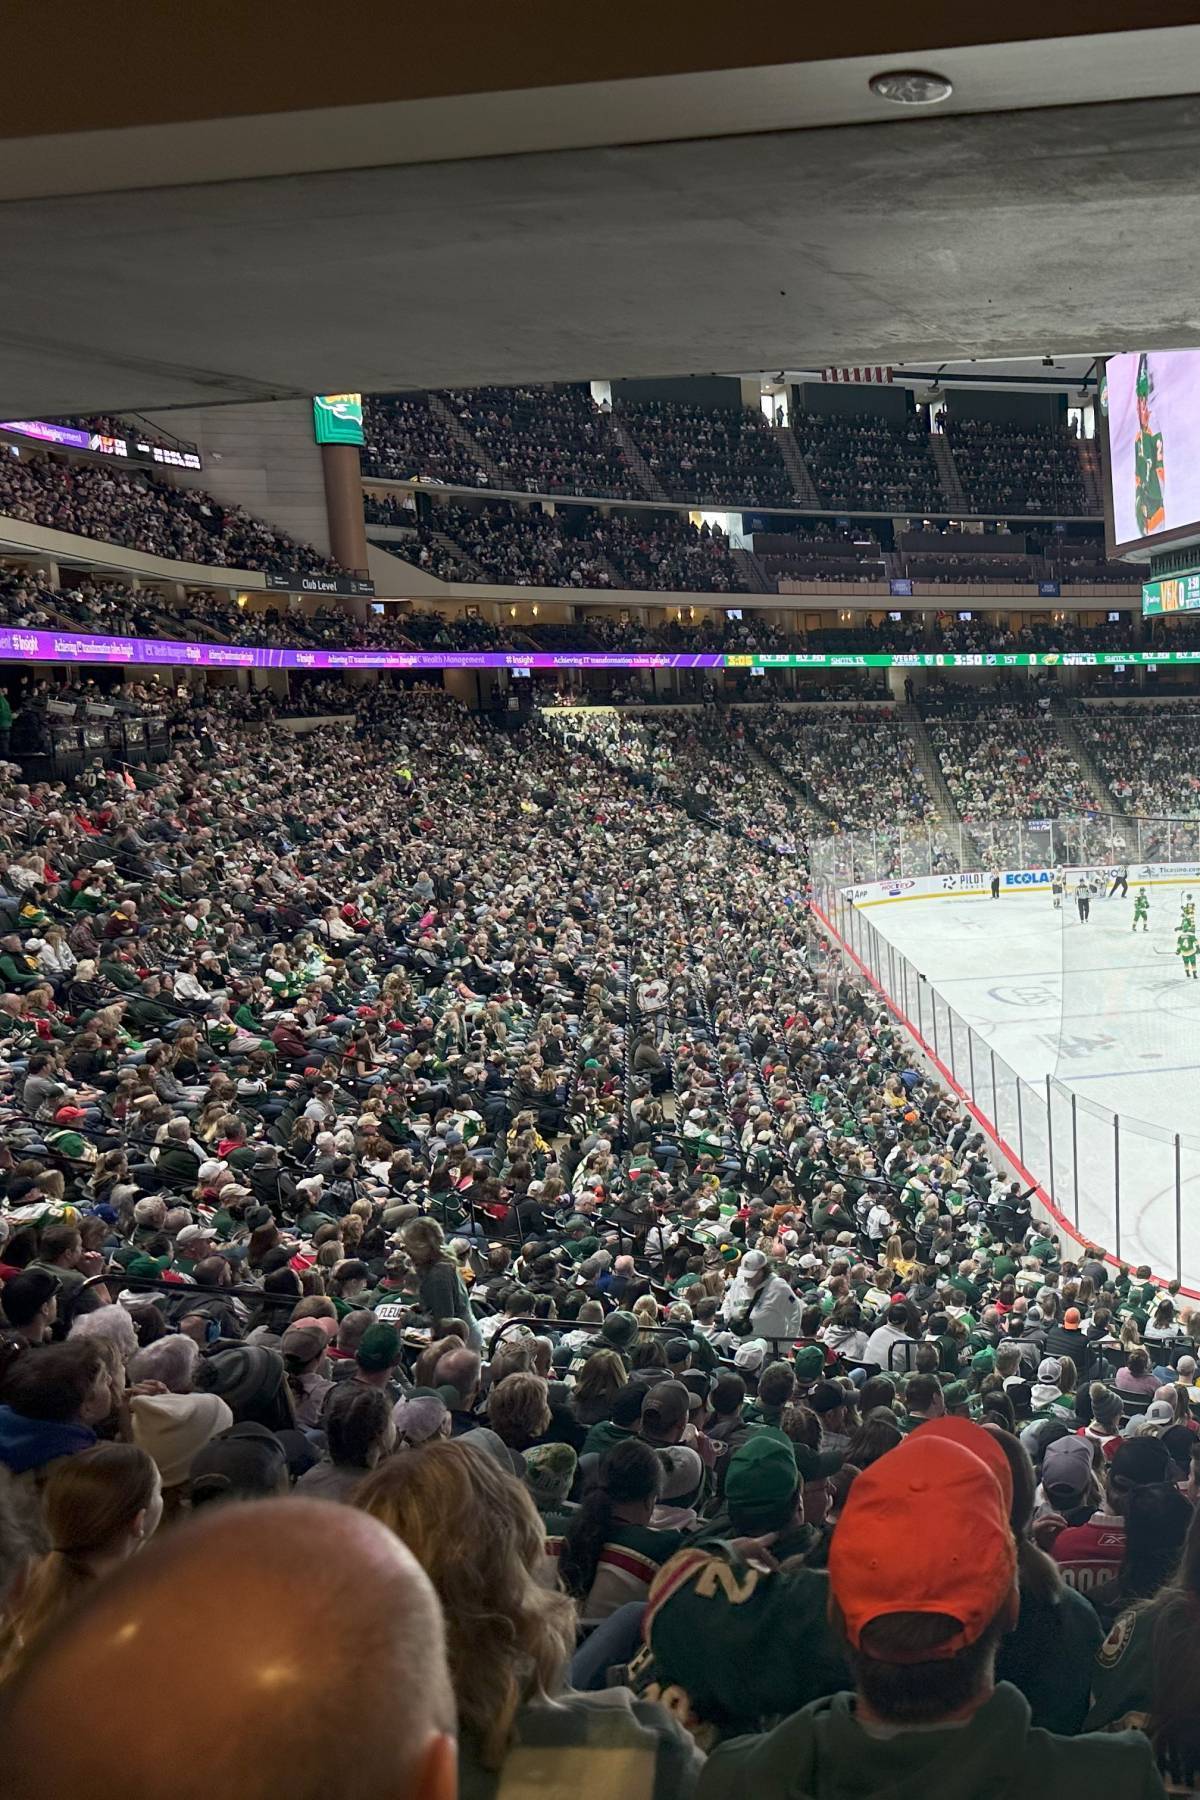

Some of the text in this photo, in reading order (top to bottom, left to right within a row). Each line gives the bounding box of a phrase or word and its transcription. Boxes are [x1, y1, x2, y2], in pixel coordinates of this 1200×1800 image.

[303, 578, 337, 592] Club Level
[422, 656, 485, 666] Wealth Management
[553, 656, 670, 666] Achieving IT transformation takes Insight
[936, 654, 1036, 666] 0 3:50 1ST 0
[1063, 655, 1096, 665] WILD
[960, 874, 984, 884] PILOT
[1006, 872, 1050, 884] ECOLA
[380, 1307, 401, 1318] FLEU
